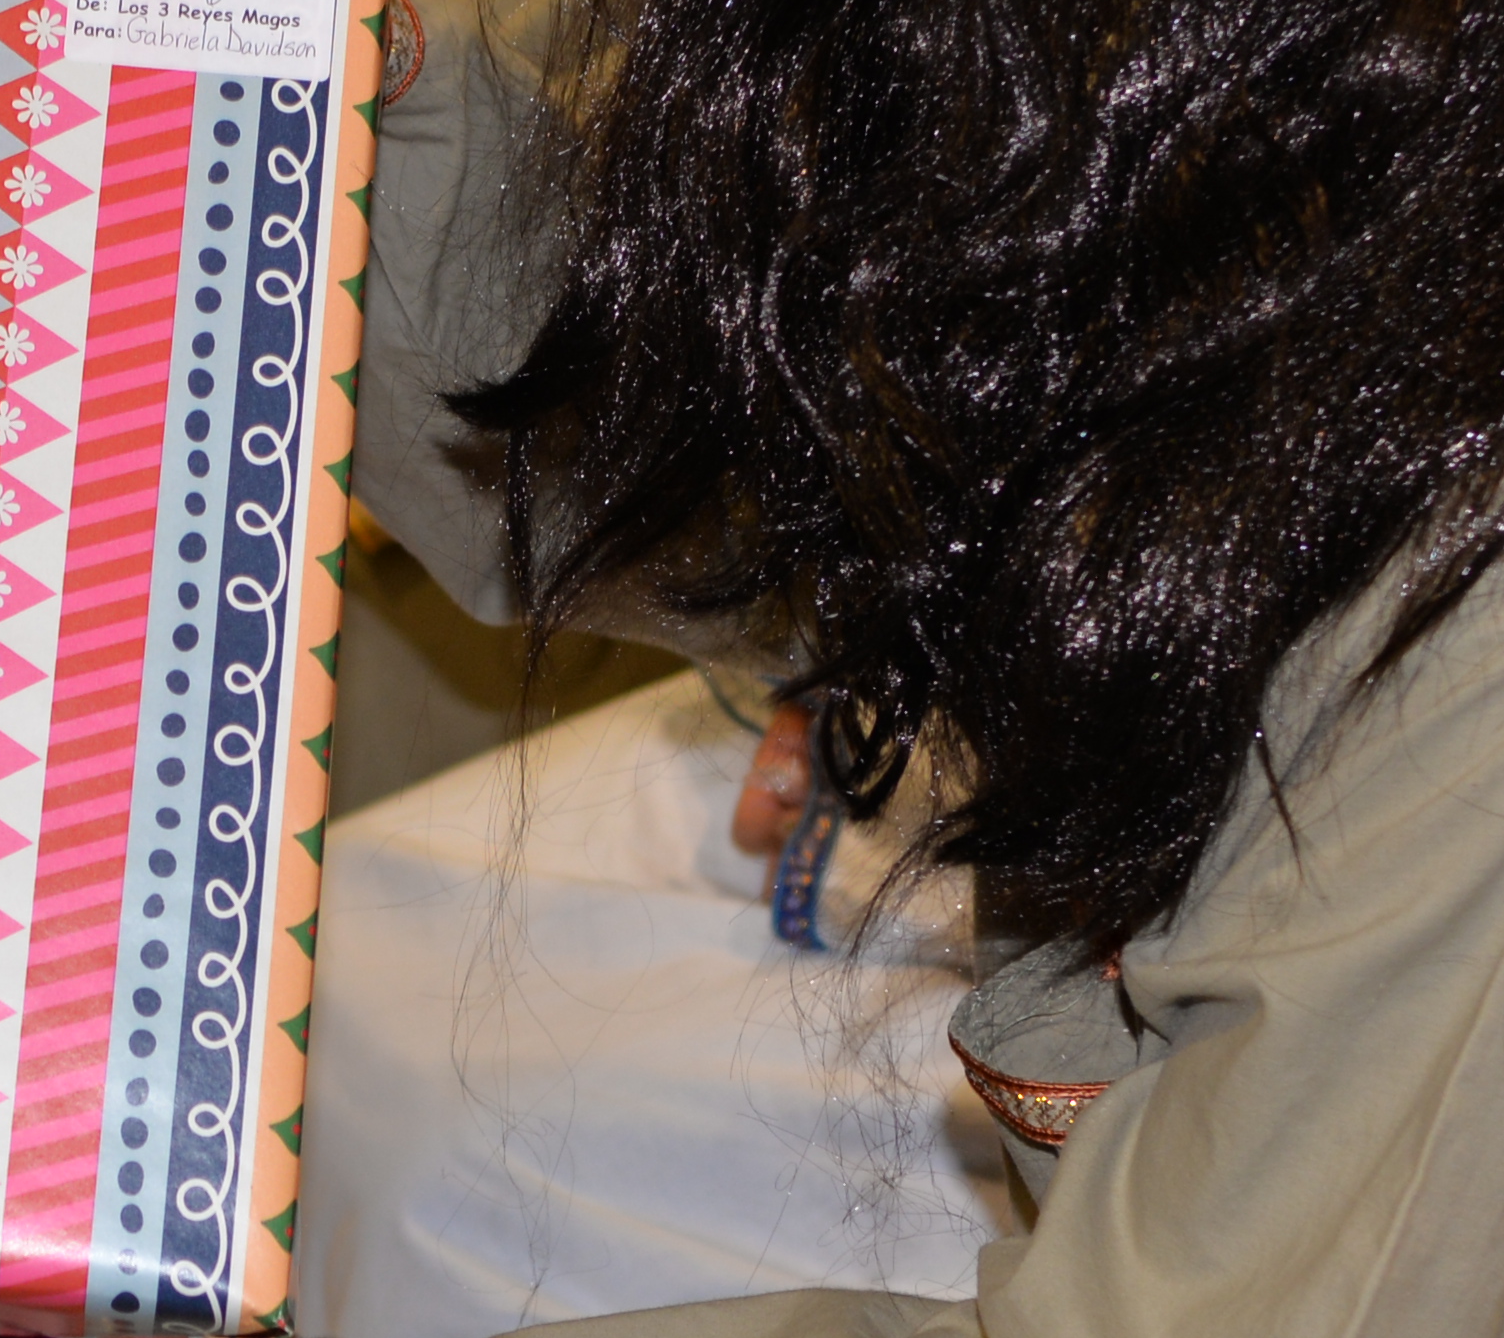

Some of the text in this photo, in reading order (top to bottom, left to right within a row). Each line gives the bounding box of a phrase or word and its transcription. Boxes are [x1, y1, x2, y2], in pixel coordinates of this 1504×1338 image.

[73, 20, 122, 39] Para:
[158, 2, 170, 17] 3
[178, 3, 234, 26] Reyes
[241, 8, 301, 31] Magos
[126, 15, 317, 58] Gabriela Davidson
